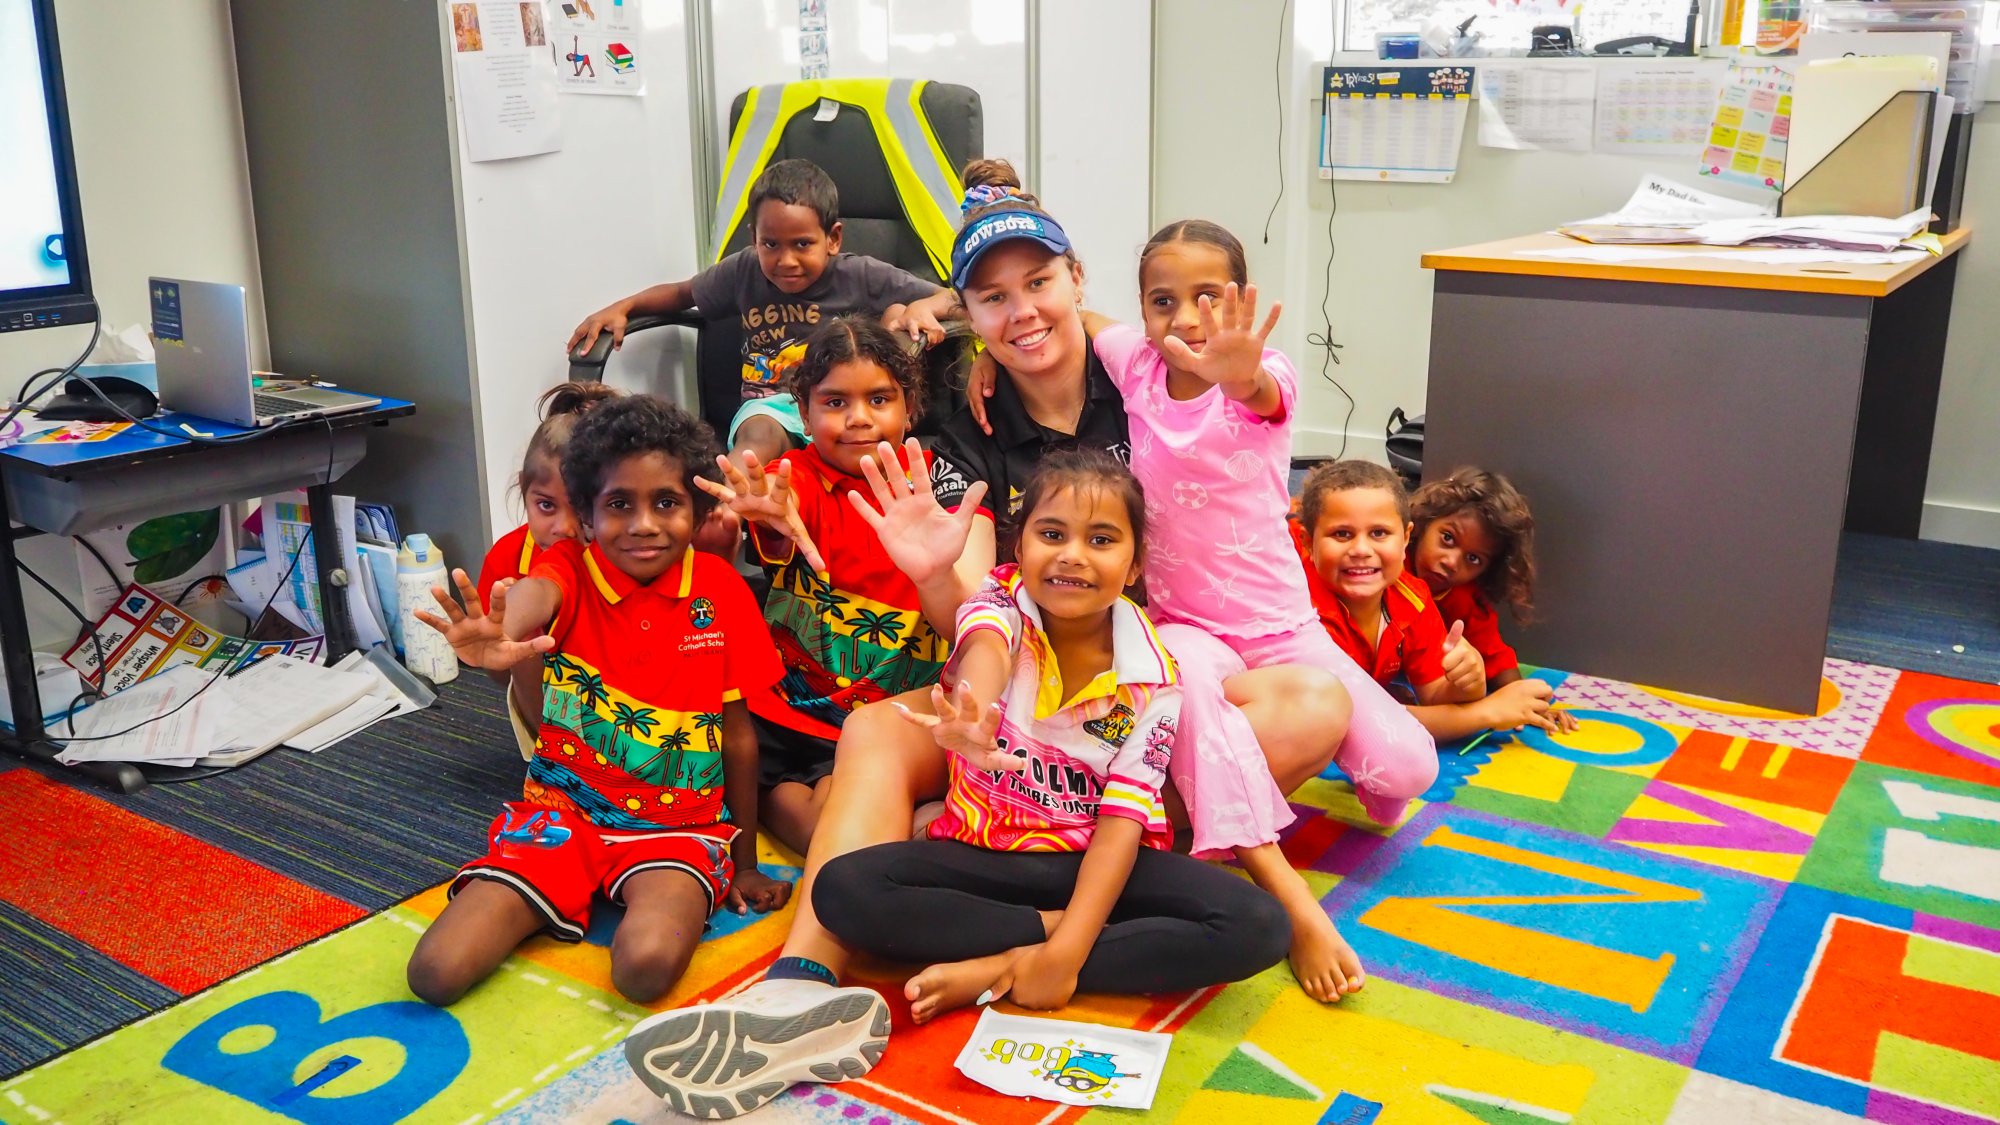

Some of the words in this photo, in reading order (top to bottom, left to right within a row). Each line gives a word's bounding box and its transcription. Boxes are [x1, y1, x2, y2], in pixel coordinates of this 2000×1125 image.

[1649, 182, 1665, 194] My
[1667, 188, 1688, 200] Dad
[964, 215, 1038, 253] COWBOYS
[934, 480, 968, 497] ratah
[937, 491, 966, 500] Foundatio
[678, 642, 706, 651] Catholic
[132, 645, 161, 672] Whisper
[114, 673, 137, 691] Voice
[991, 1039, 1071, 1070] Bob
